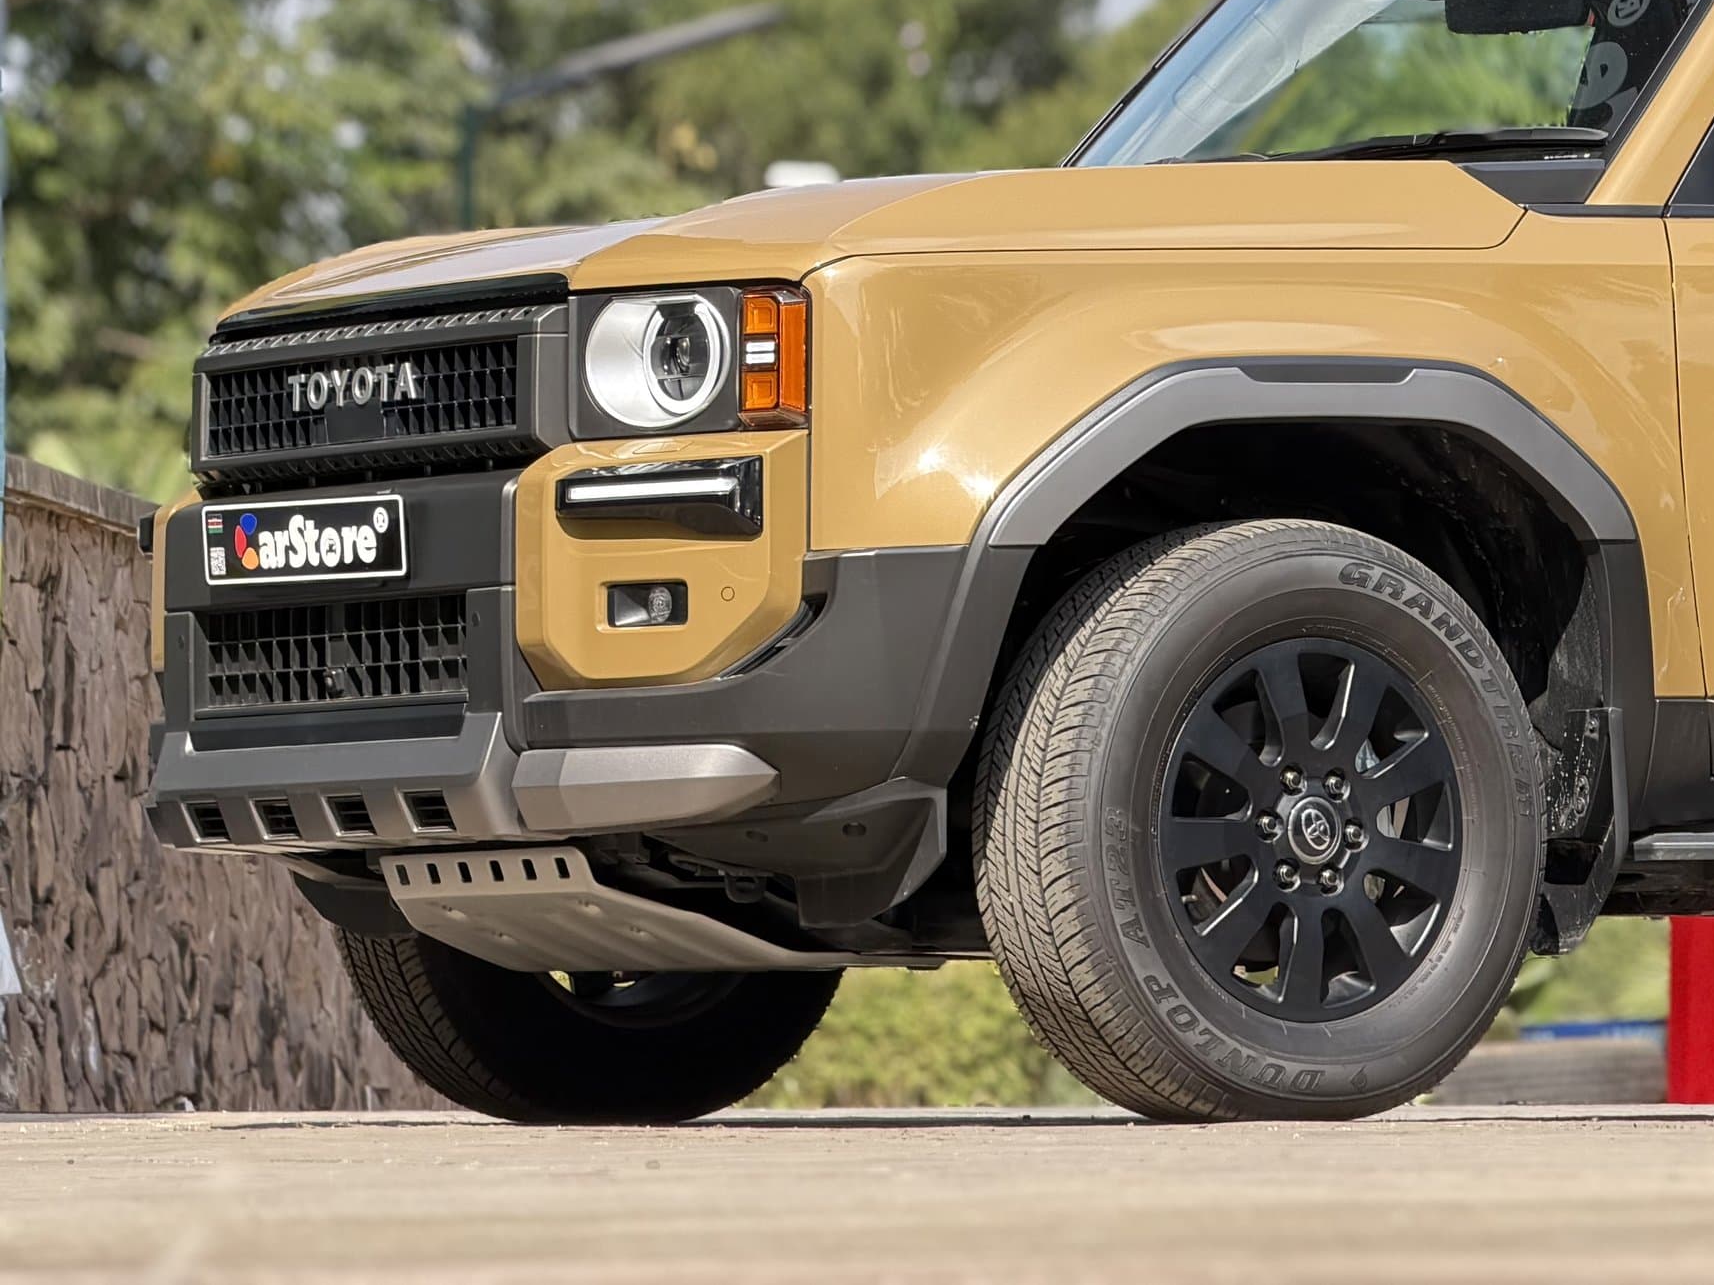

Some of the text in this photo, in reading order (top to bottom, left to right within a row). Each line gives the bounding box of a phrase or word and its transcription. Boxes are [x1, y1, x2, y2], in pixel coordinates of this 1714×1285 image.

[287, 362, 417, 412] TOYOTA
[1105, 807, 1326, 1092] DUNLOP AT23
